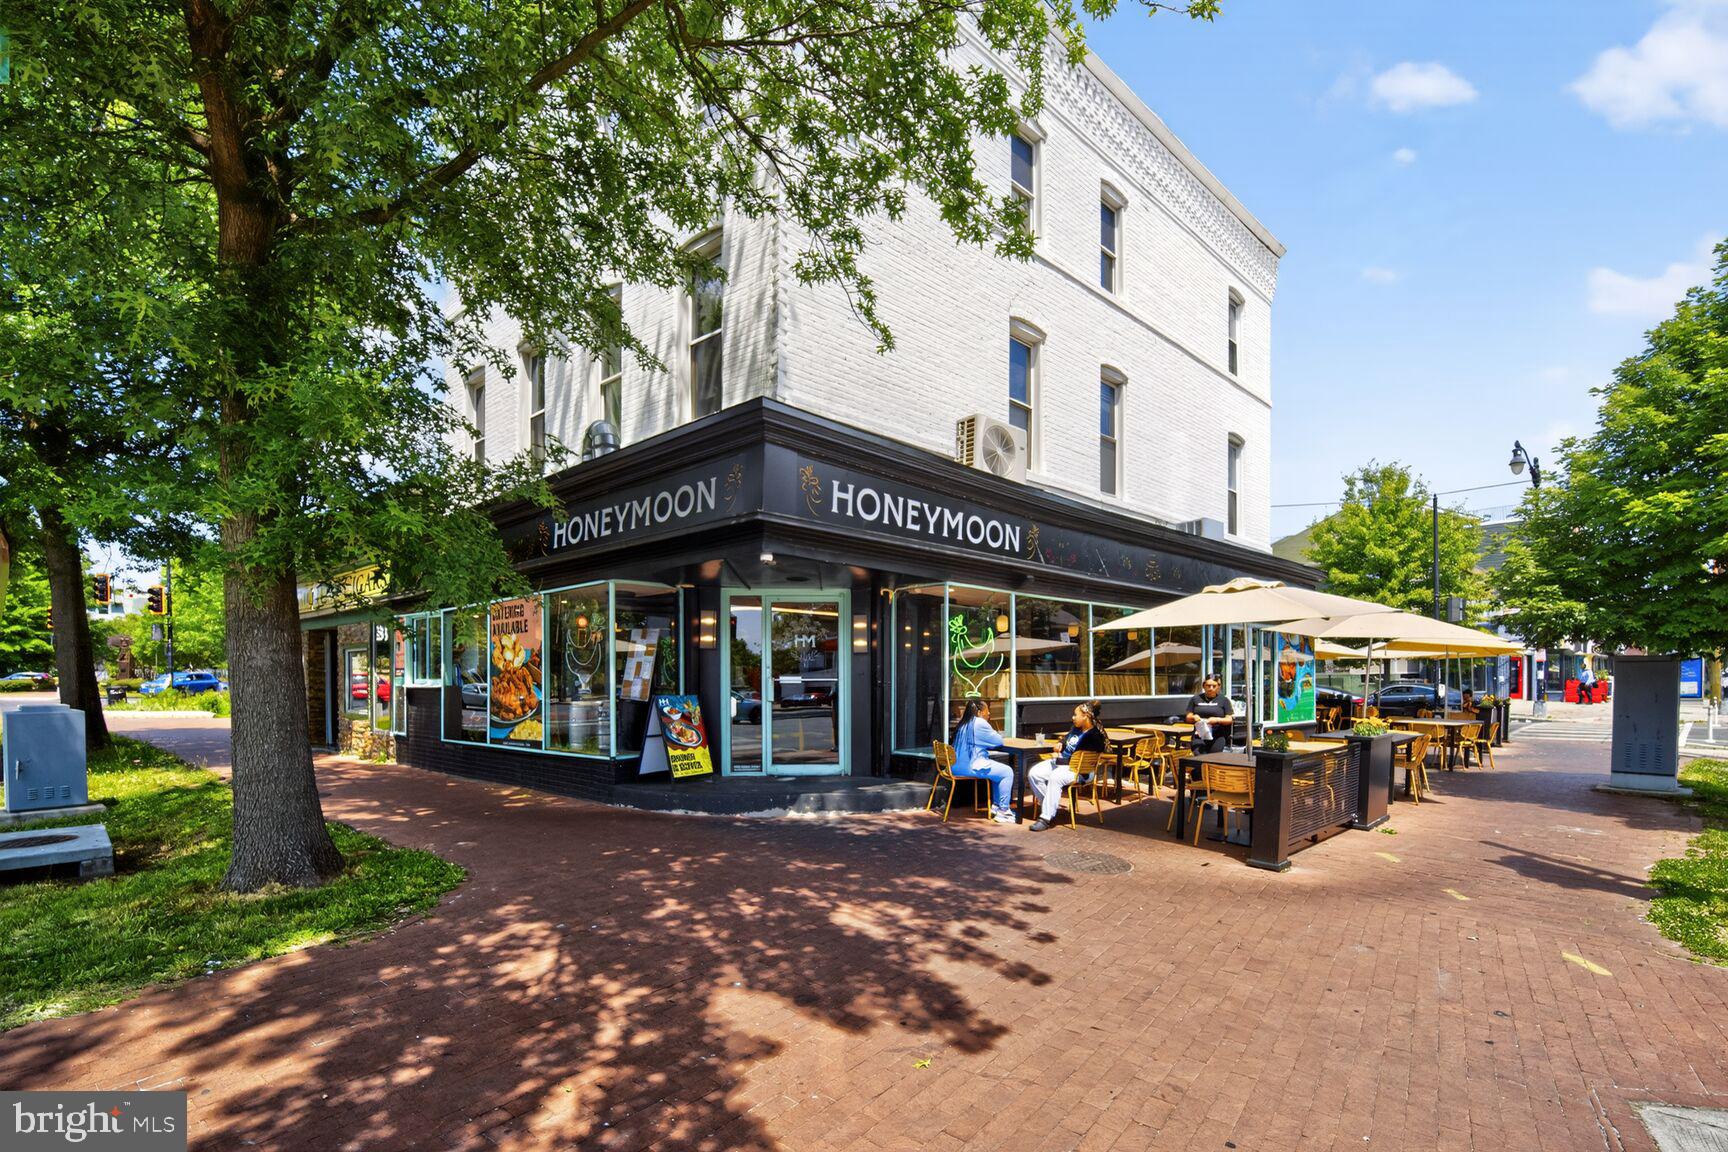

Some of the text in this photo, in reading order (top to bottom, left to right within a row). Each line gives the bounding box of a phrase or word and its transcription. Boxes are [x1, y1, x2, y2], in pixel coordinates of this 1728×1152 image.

[553, 477, 717, 549] HONEYMOON
[831, 480, 1021, 552] HONEYMOON
[492, 619, 529, 637] AVAILABLE
